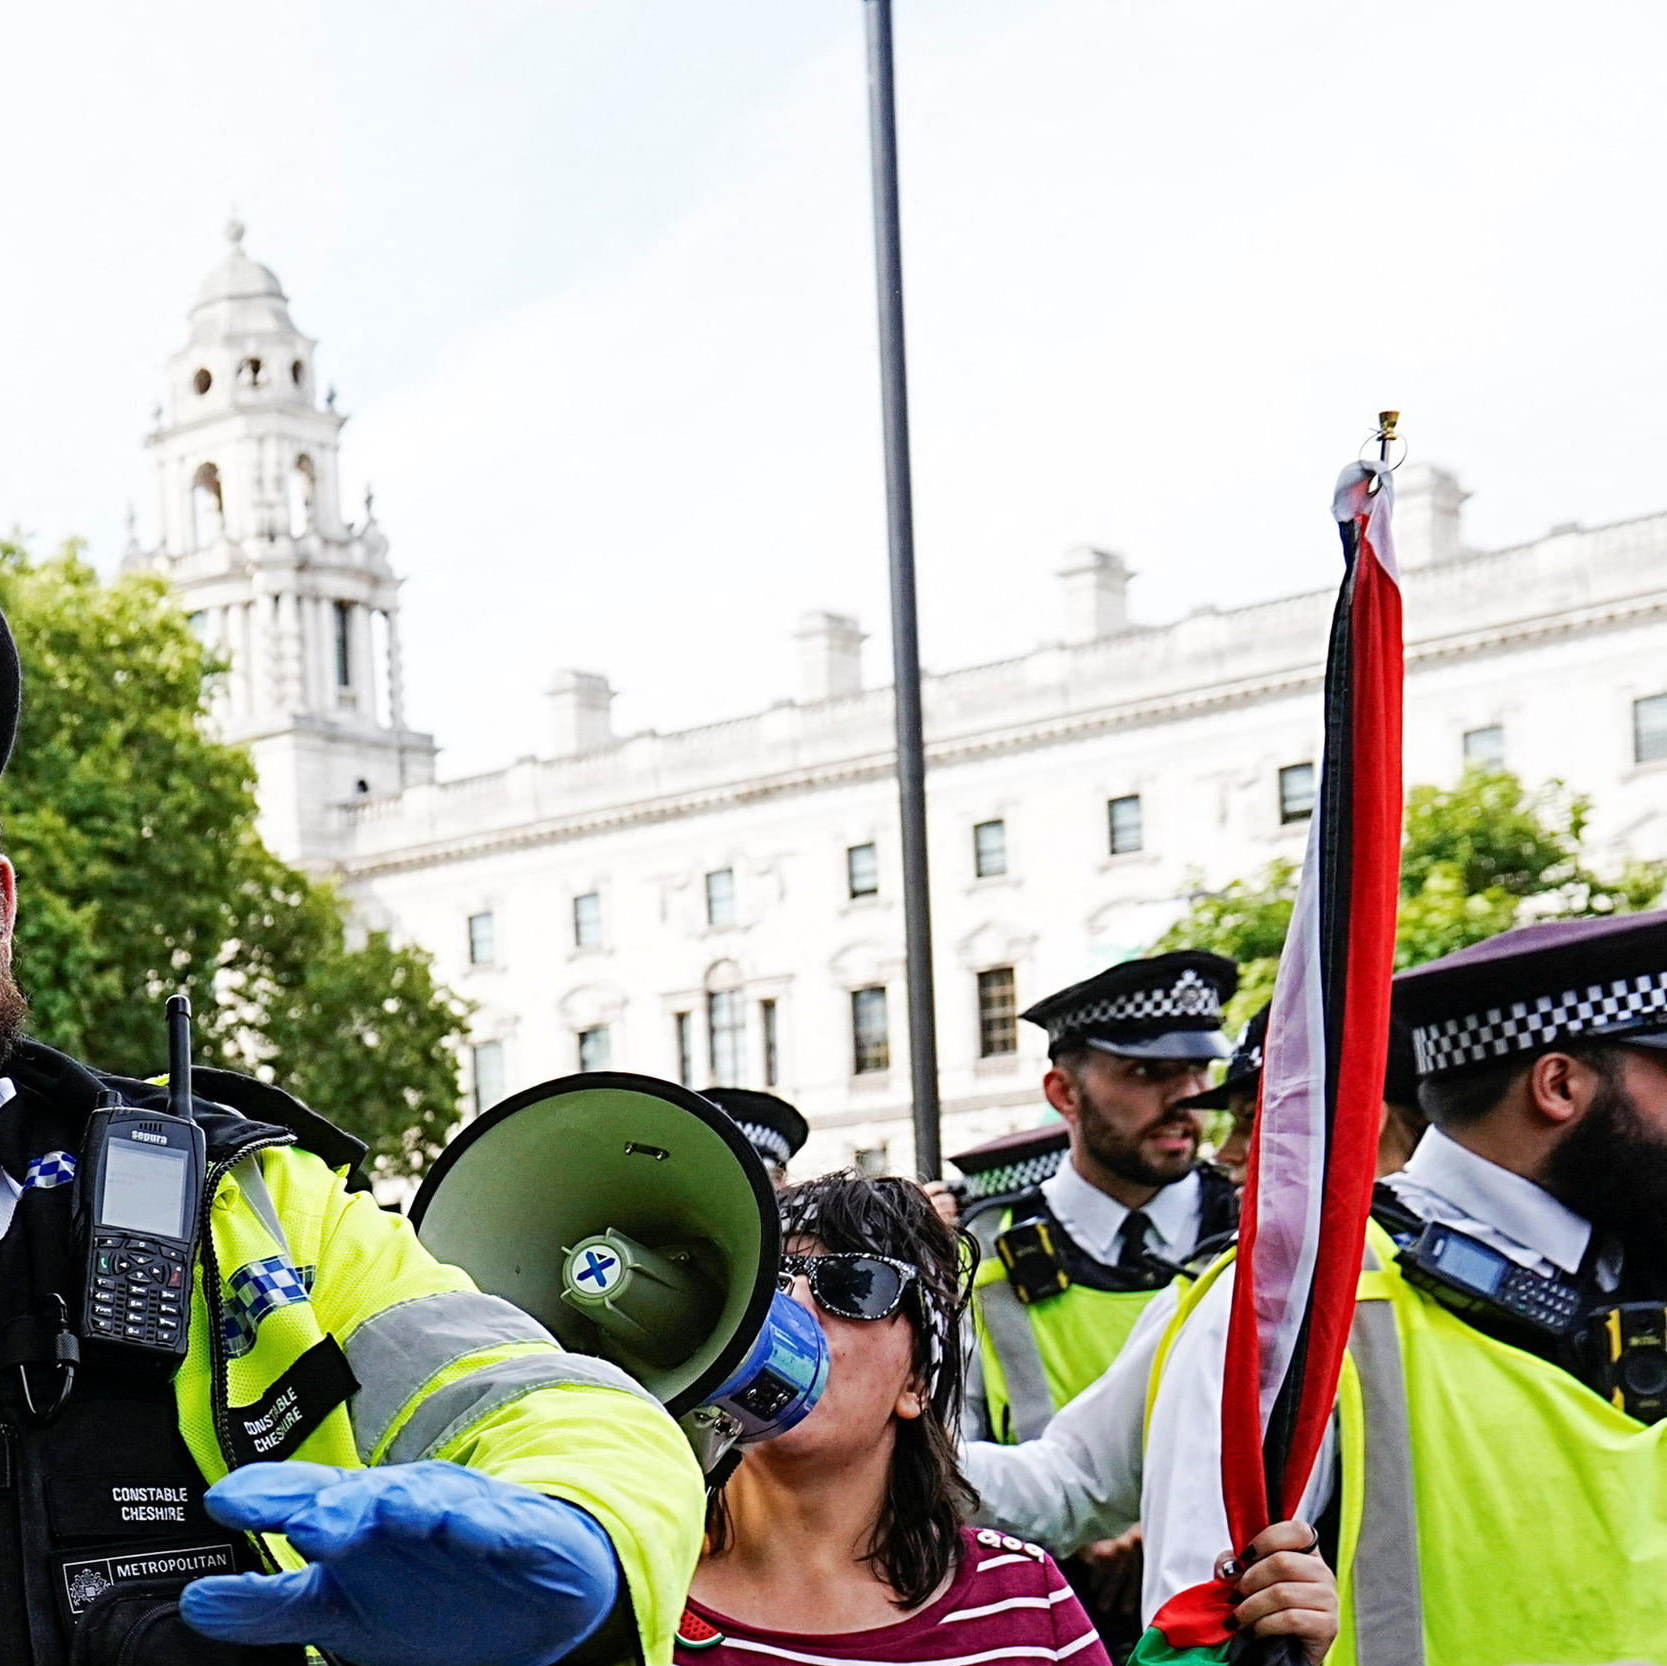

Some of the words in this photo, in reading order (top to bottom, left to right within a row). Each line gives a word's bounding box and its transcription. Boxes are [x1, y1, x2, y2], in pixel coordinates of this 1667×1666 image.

[131, 1129, 168, 1145] sepura
[254, 1406, 303, 1453] CHESHIRE
[112, 1487, 188, 1502] CONSTABLE
[121, 1506, 185, 1522] CHESHIRE
[117, 1553, 227, 1578] METROPOLITAN
